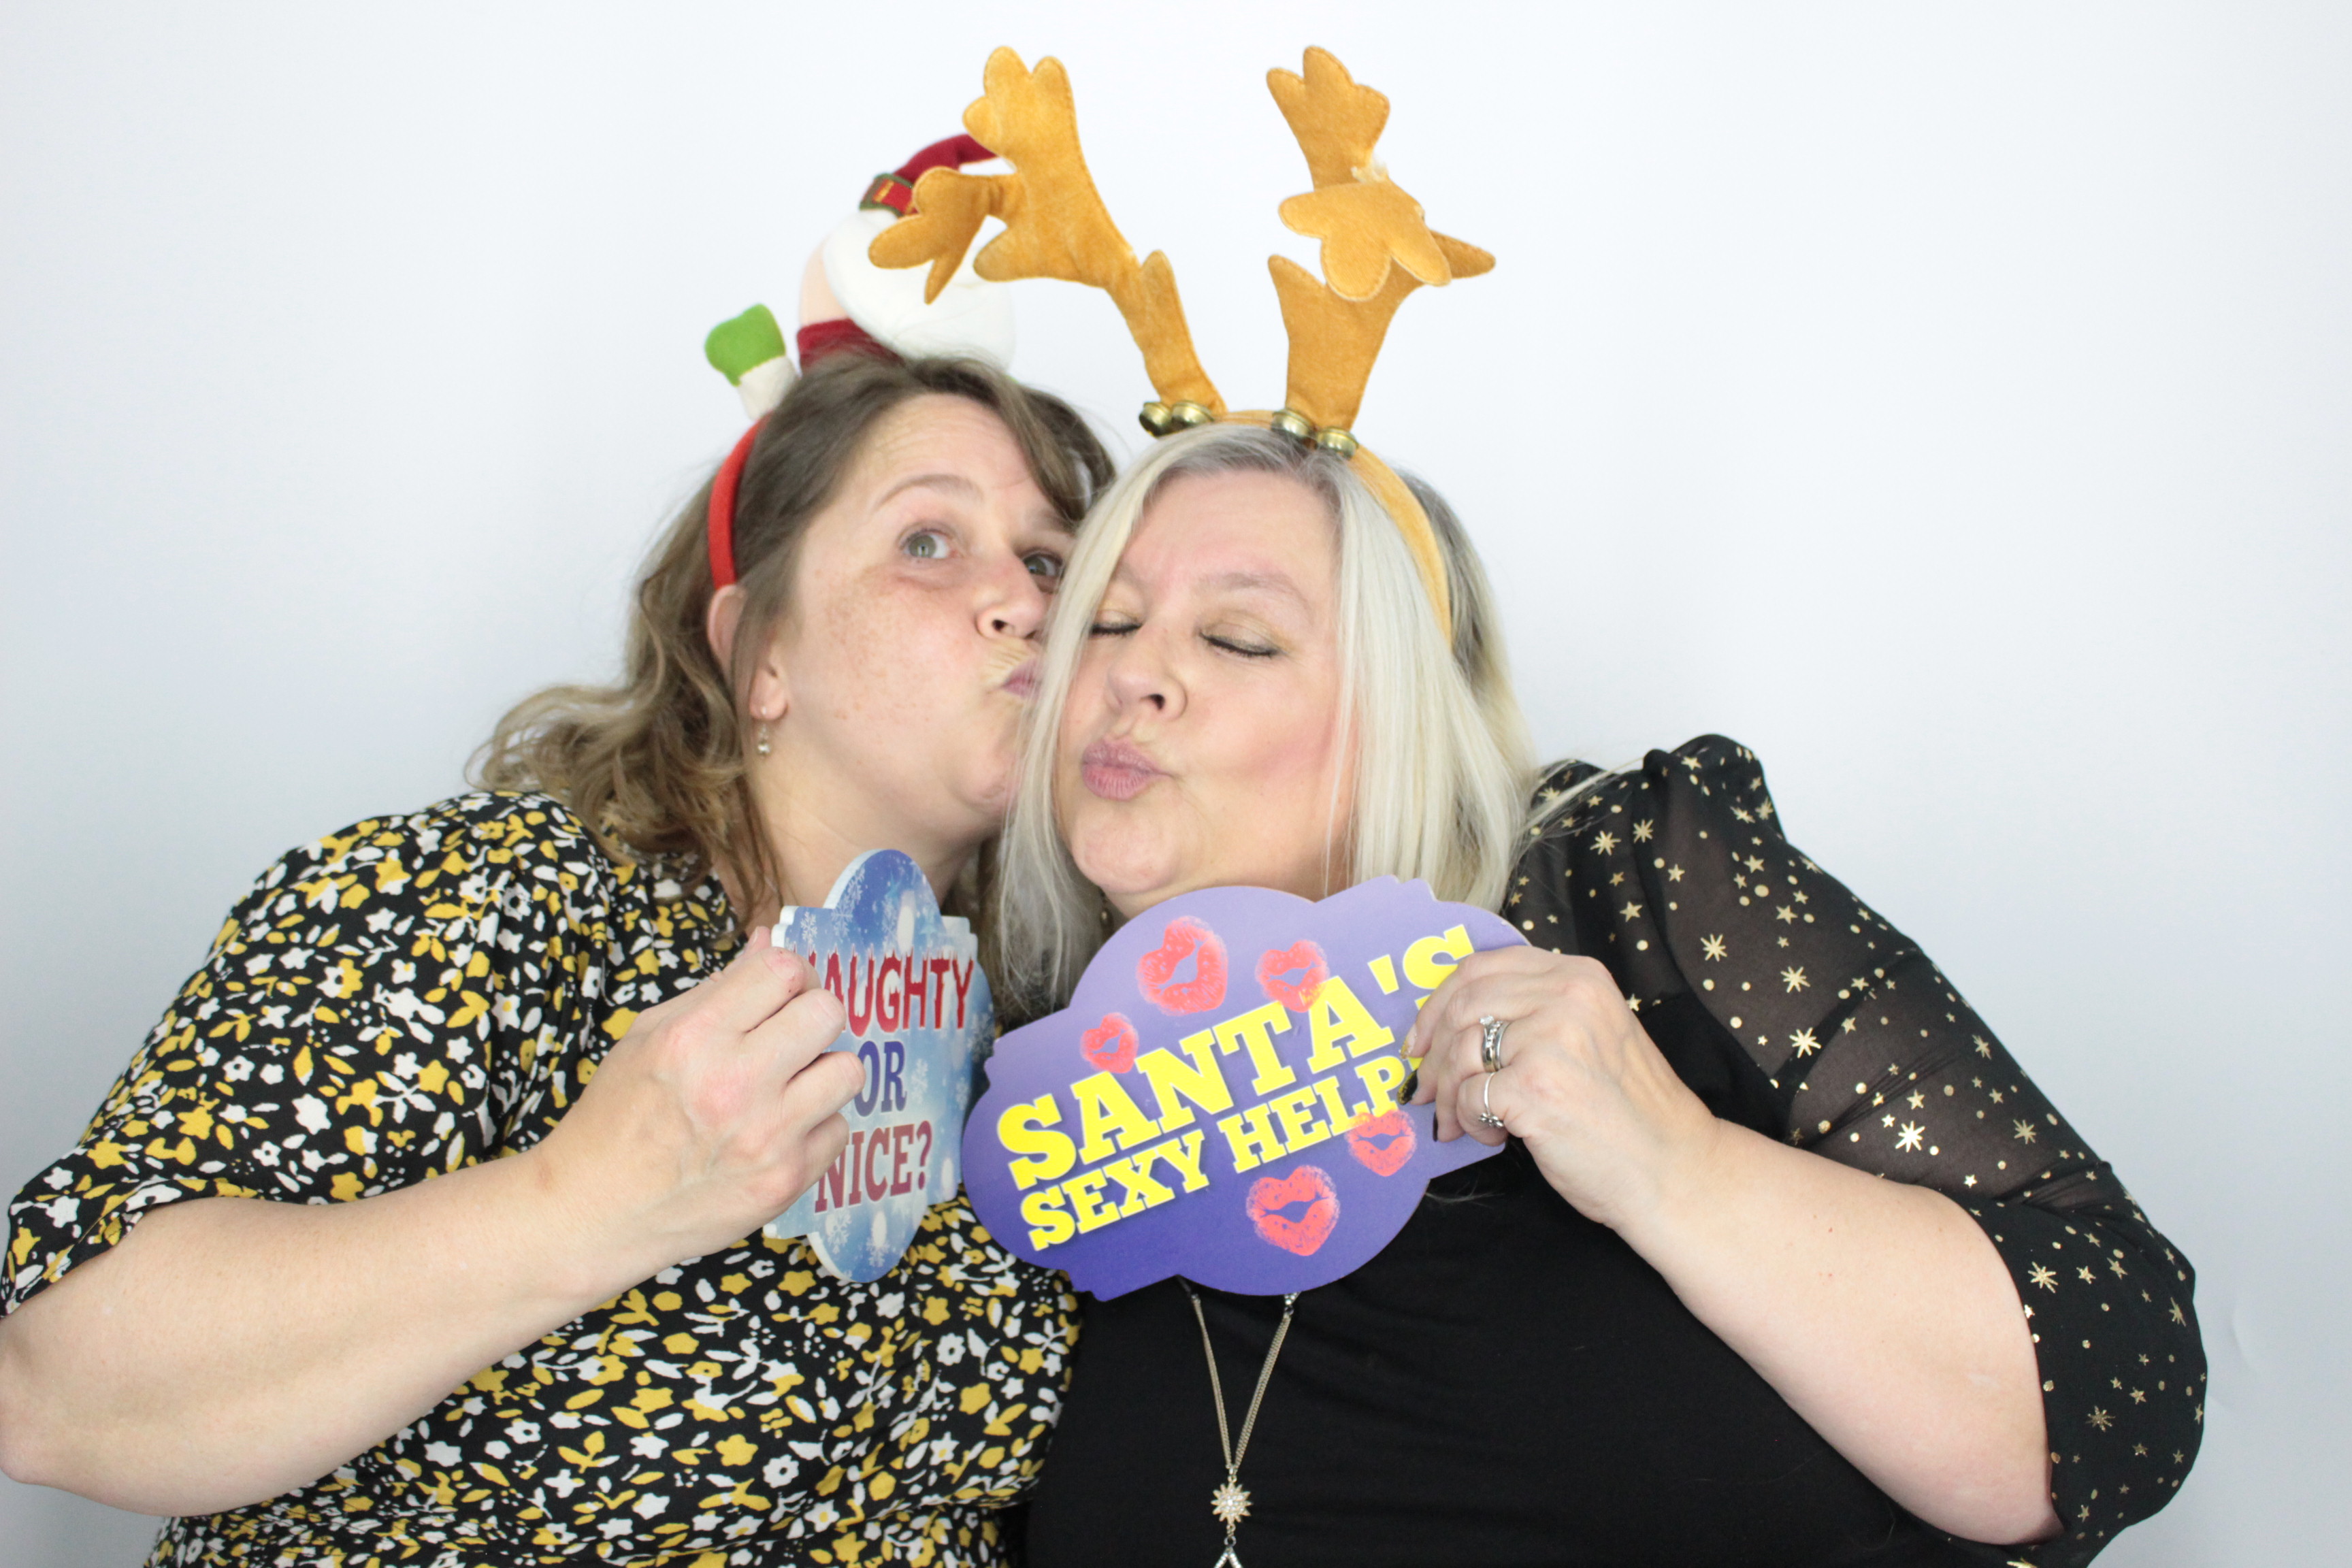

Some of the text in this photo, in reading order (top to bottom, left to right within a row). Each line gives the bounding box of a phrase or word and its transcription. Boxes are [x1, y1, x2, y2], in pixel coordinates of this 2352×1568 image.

[794, 942, 975, 1038] AUGHTY
[853, 1040, 907, 1117] OR
[997, 924, 1475, 1190] SANTA'S
[814, 1120, 933, 1214] NICE?
[1019, 1053, 1424, 1251] SEXY HELP
